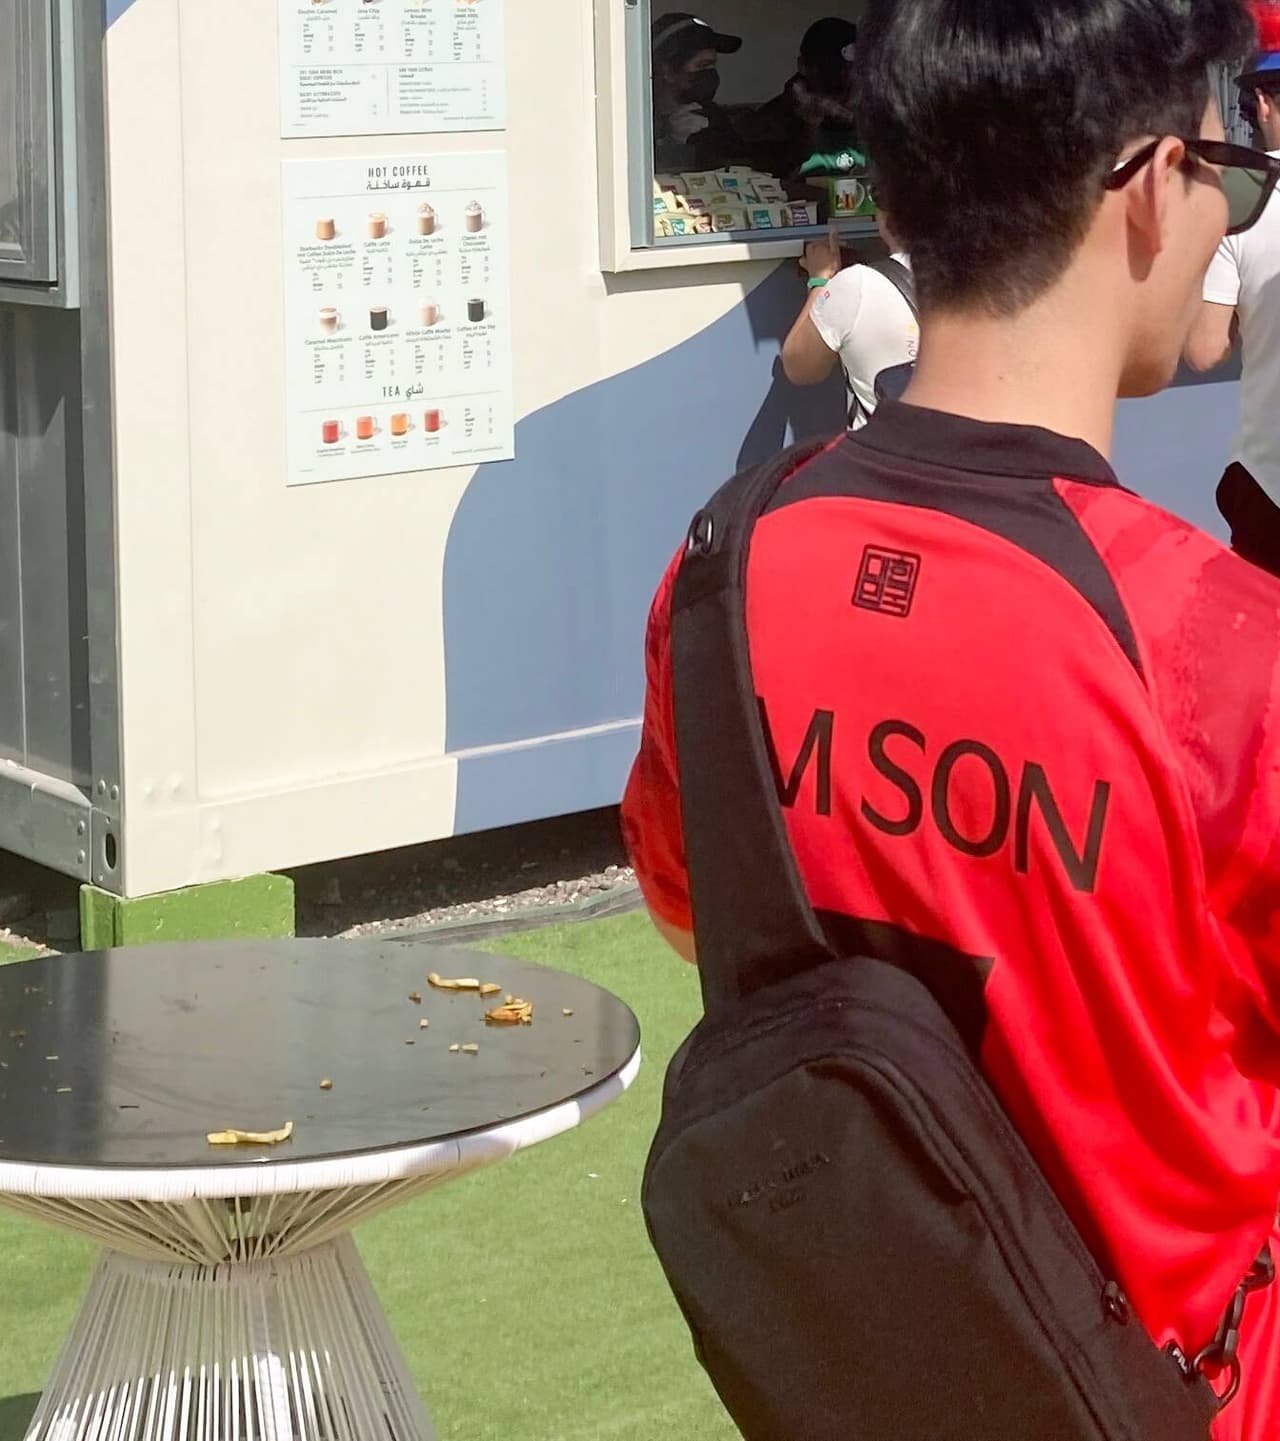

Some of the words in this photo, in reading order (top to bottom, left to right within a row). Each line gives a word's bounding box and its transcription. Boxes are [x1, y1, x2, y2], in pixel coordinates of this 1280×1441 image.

[367, 166, 387, 178] HOT
[392, 164, 429, 177] COFFEE
[381, 384, 401, 398] TEA
[860, 719, 1111, 894] SON
